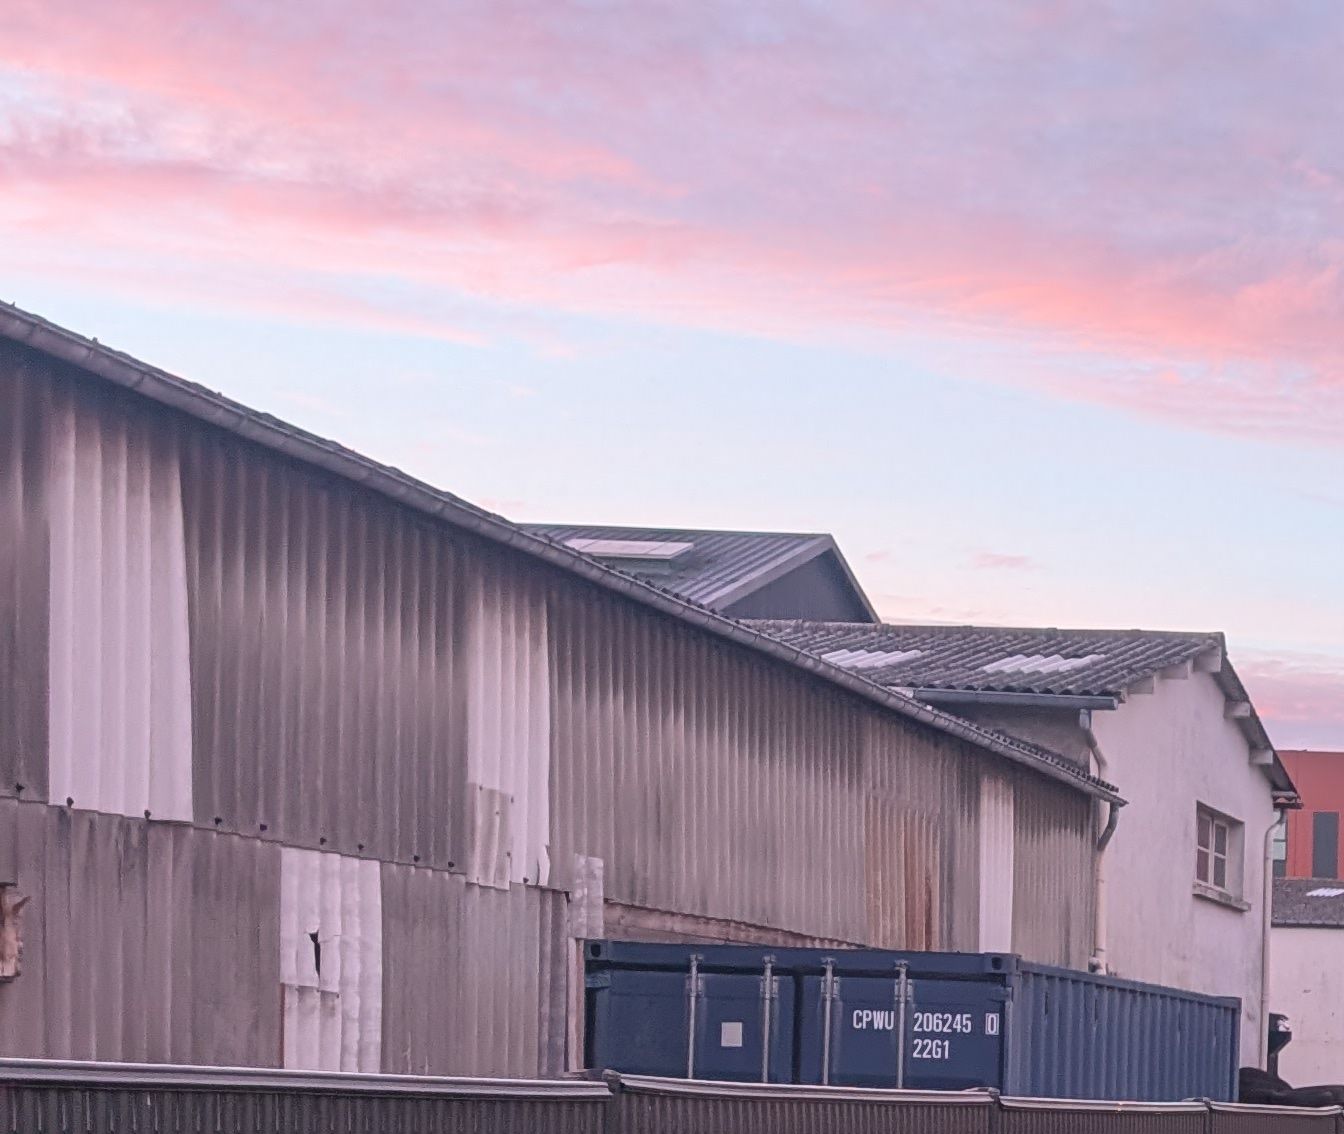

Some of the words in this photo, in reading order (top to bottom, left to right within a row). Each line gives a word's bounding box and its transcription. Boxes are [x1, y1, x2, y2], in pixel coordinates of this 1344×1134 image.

[852, 1009, 895, 1030] CPWU
[913, 1012, 972, 1034] 206245
[912, 1038, 950, 1060] 22G1
